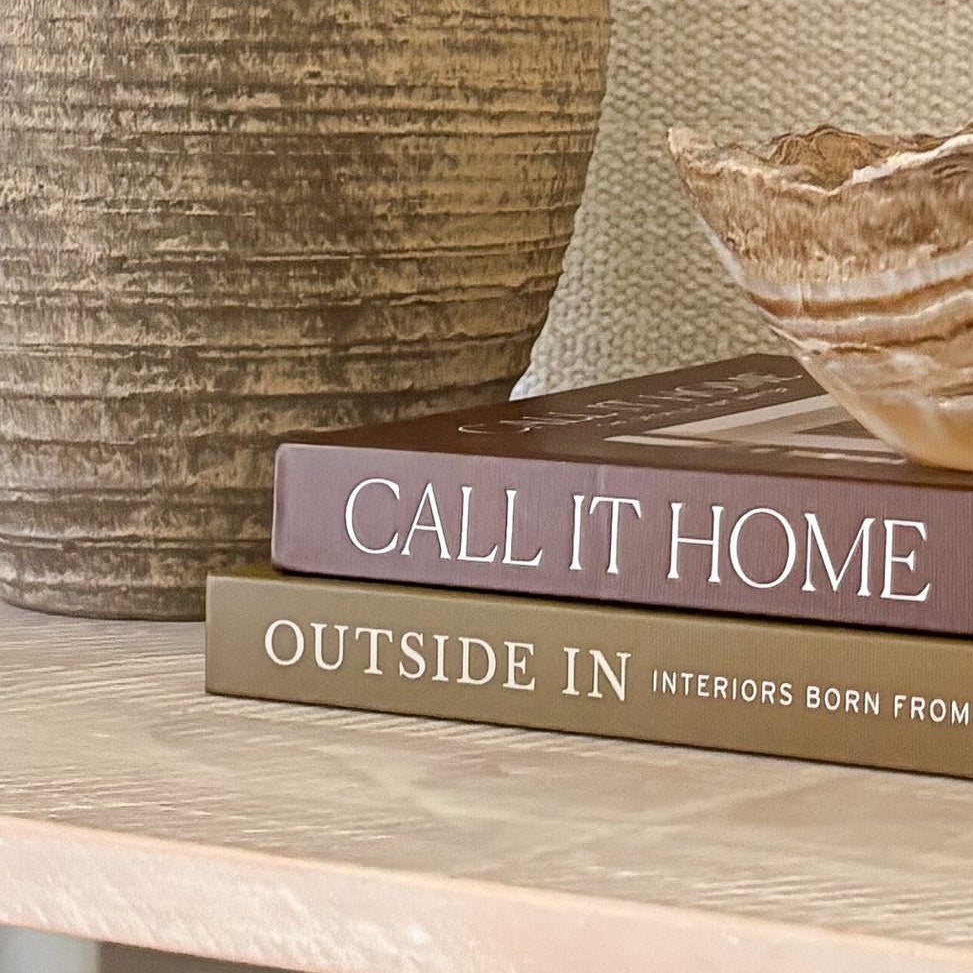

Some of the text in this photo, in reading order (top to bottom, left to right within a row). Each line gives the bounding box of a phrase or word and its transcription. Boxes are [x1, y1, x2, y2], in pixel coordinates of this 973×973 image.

[345, 478, 931, 602] CALL IT HOME
[264, 619, 632, 702] OUTSIDE IN
[652, 669, 793, 706] INTERIORS
[806, 685, 880, 716] BORN
[893, 694, 970, 726] FROM
